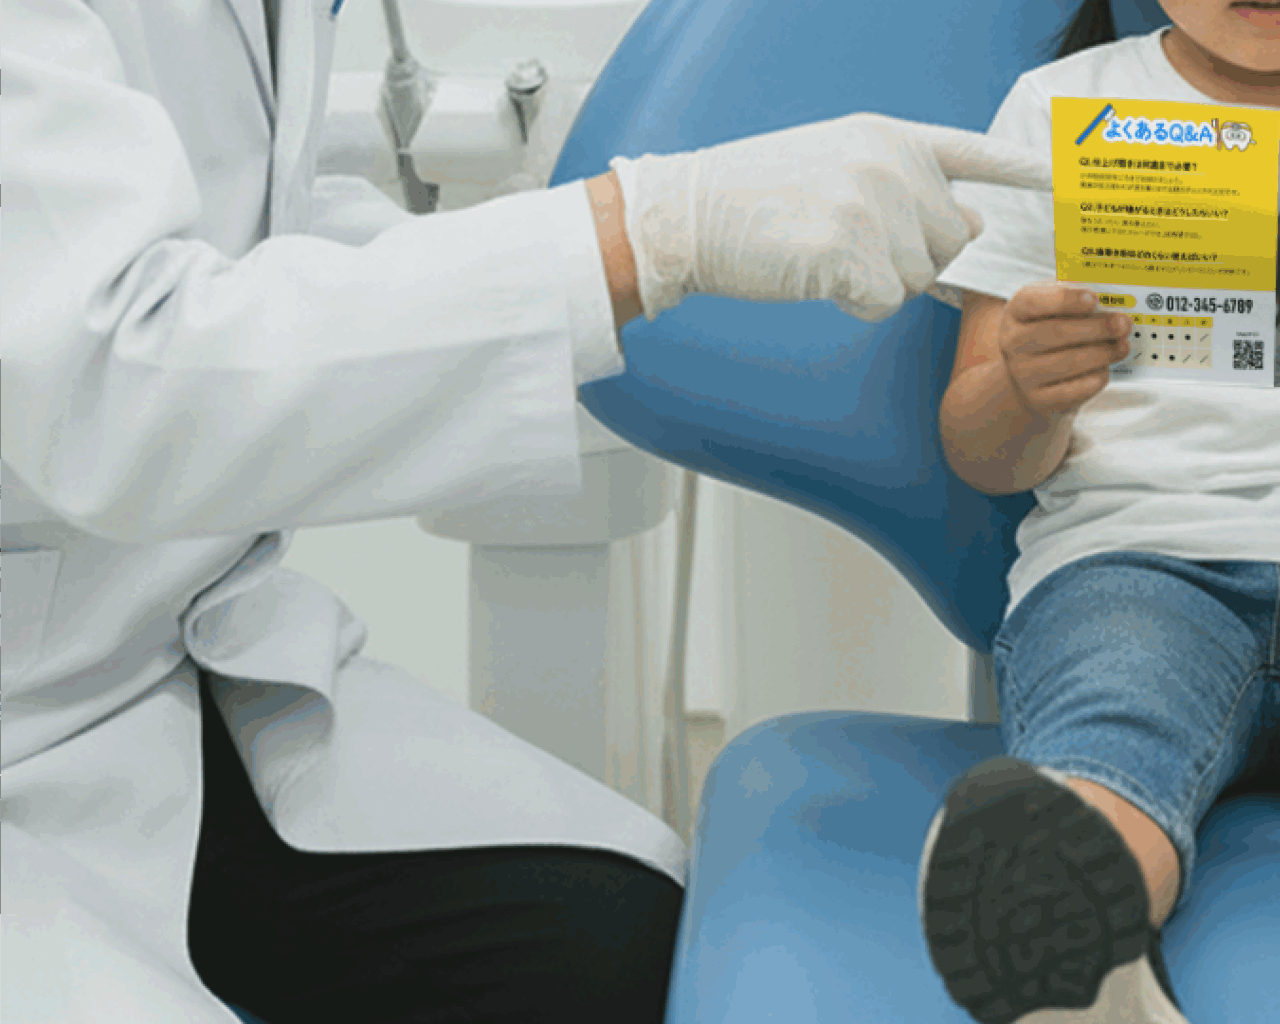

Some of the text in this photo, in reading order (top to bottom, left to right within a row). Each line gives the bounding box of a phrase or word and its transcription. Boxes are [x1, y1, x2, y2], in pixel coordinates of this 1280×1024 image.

[1105, 120, 1214, 143] よくあるQ&A
[1166, 295, 1253, 314] 012-345-6789
